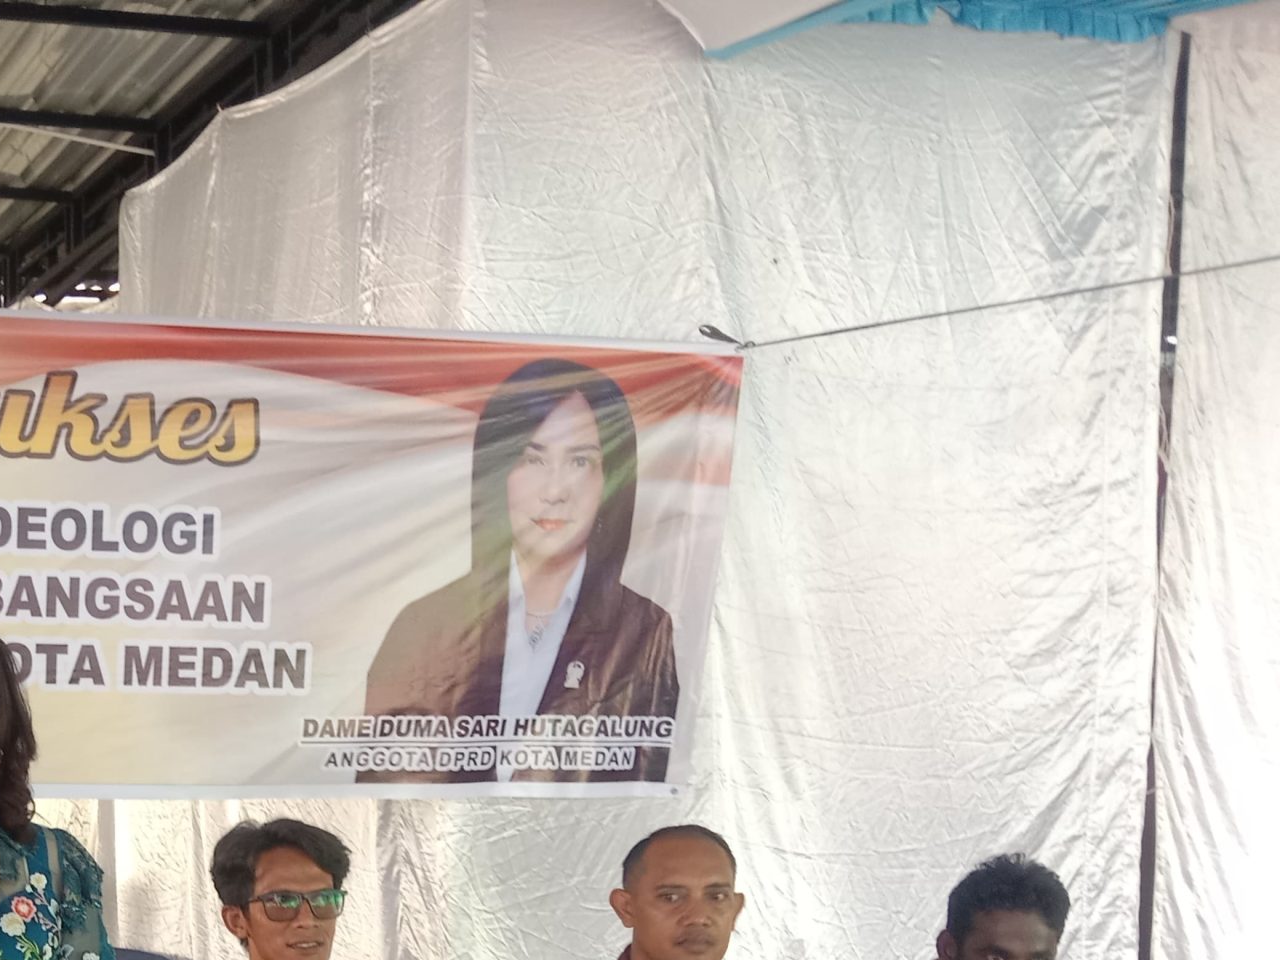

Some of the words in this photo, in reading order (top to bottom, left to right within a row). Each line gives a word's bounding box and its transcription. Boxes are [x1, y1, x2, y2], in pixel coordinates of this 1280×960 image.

[124, 646, 307, 690] MEDAN
[303, 719, 372, 738] DAME
[378, 719, 451, 738] DUMA
[456, 718, 506, 738] SARI
[513, 719, 673, 738] HUTAGALUNG
[324, 750, 433, 768] ANGGOTA
[438, 751, 494, 768] DPRD
[499, 750, 558, 768] KOTA
[563, 750, 634, 768] MEDAN
